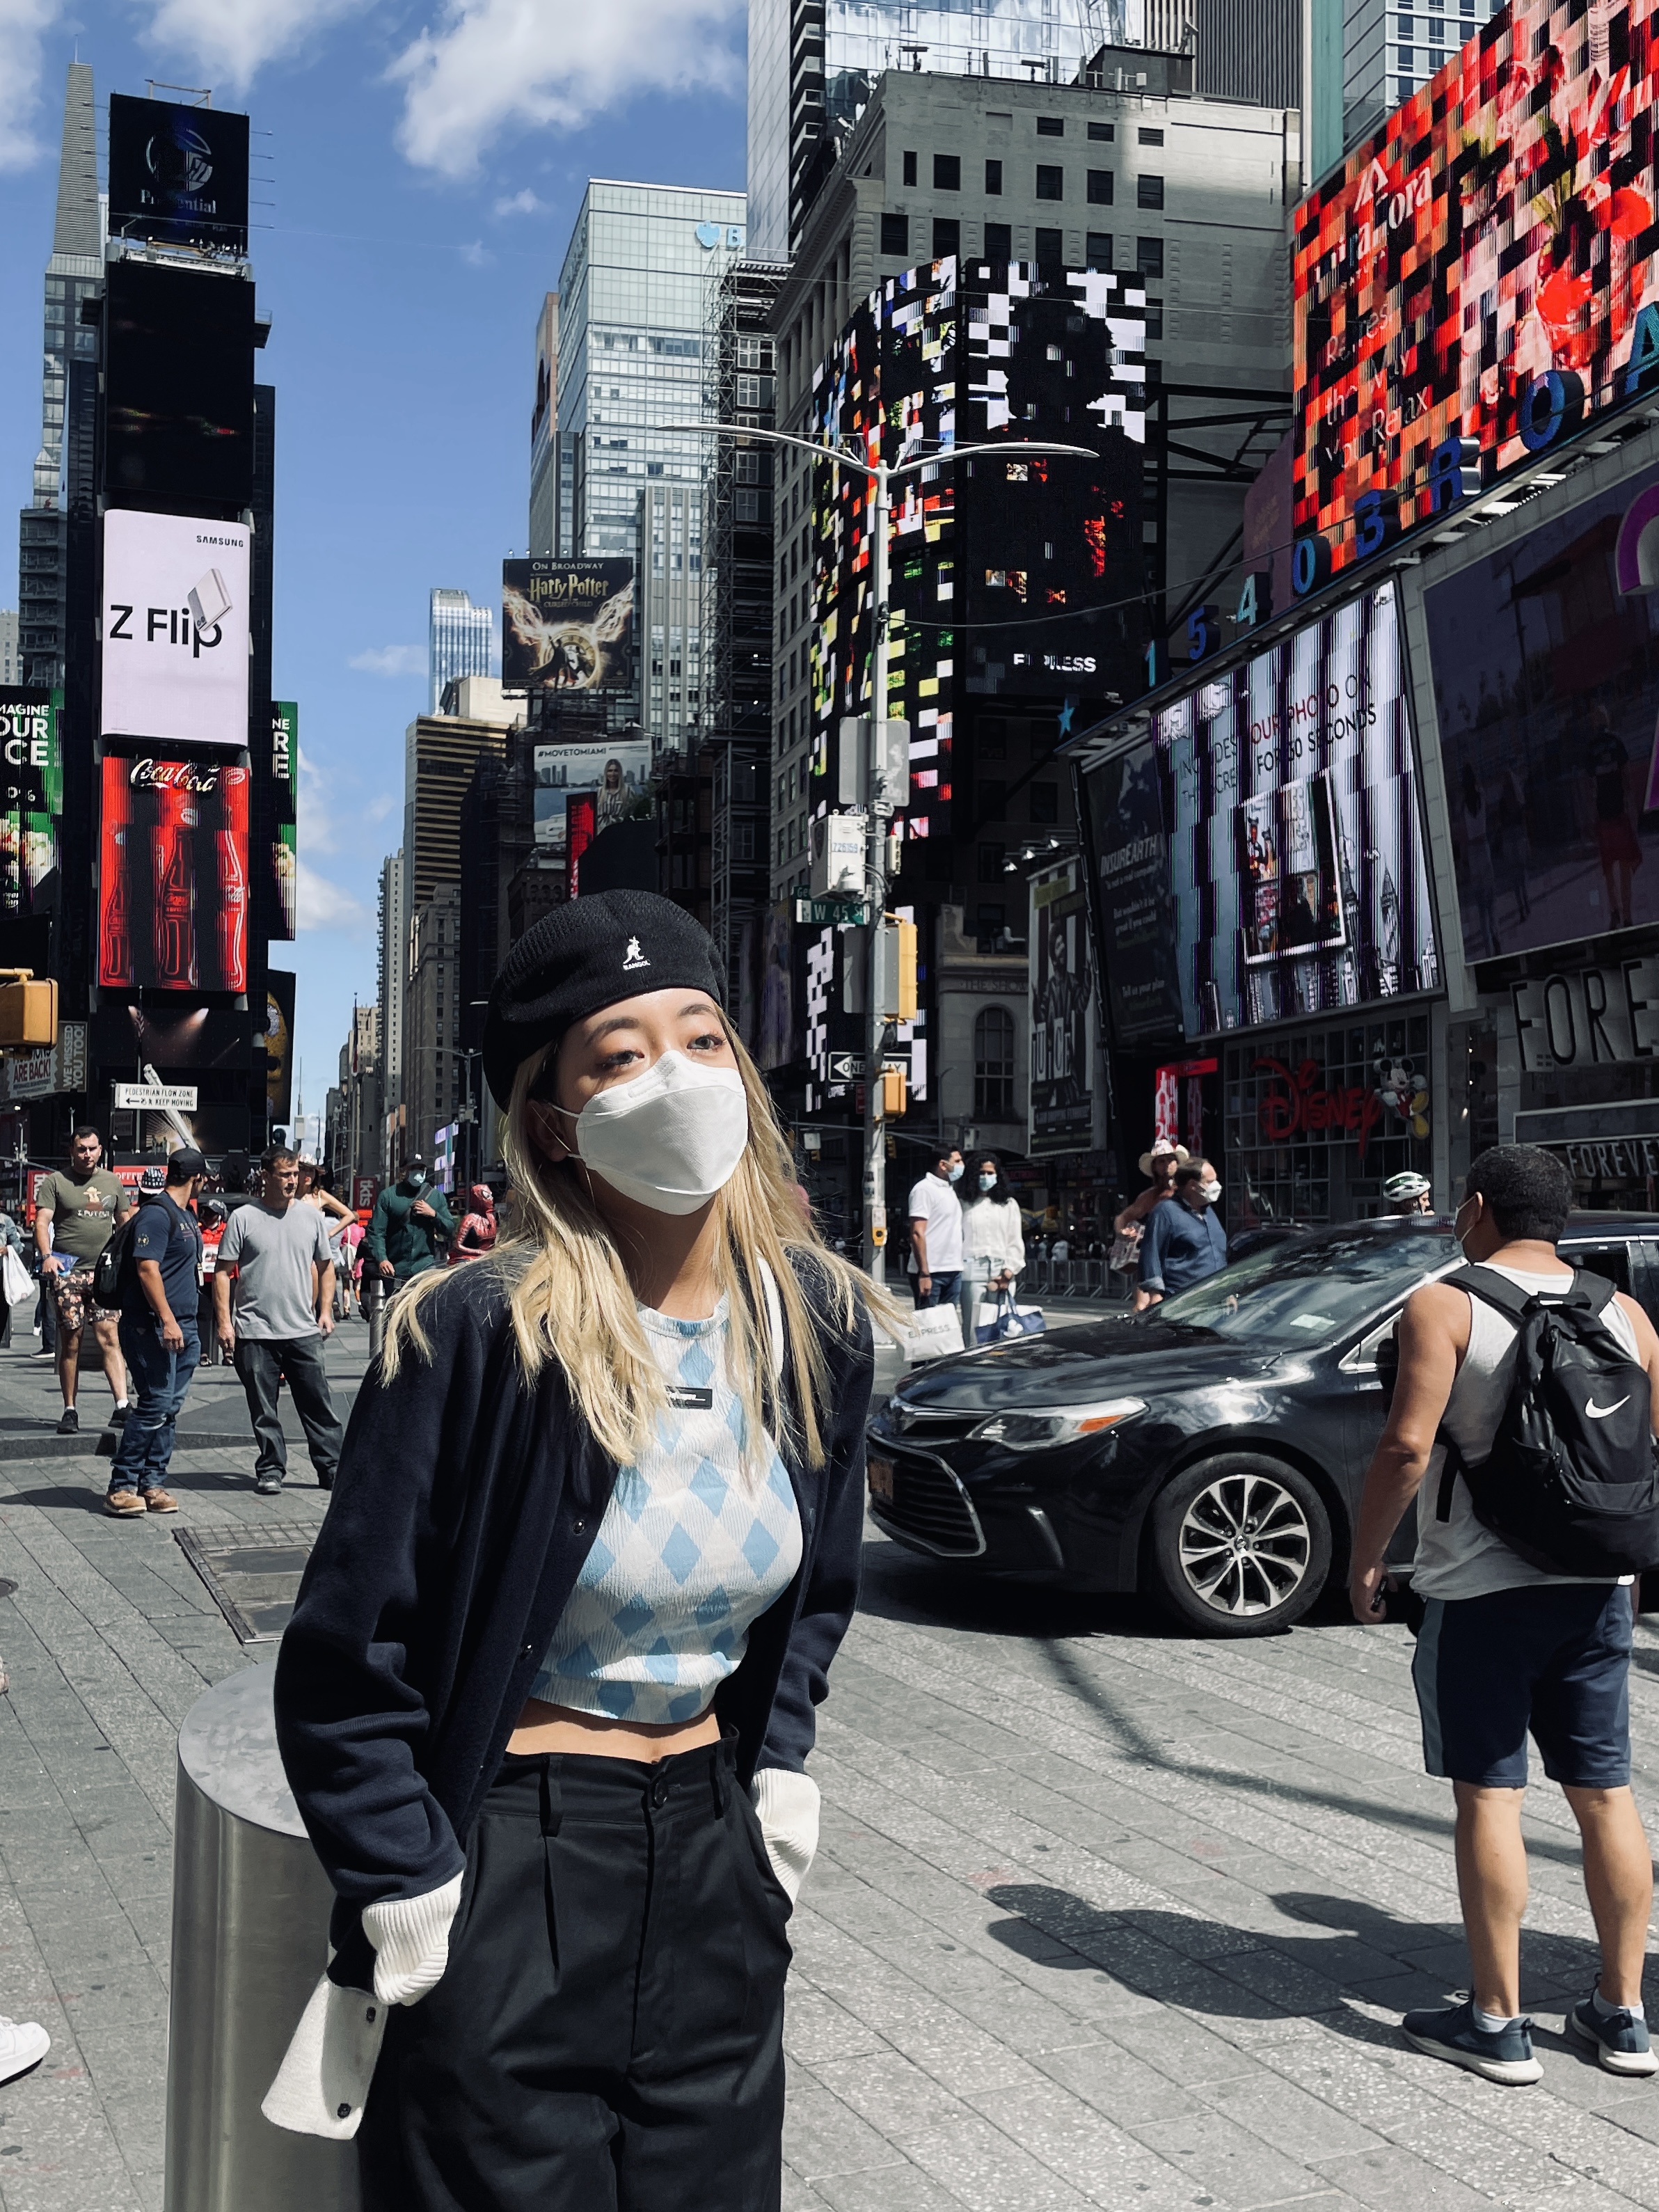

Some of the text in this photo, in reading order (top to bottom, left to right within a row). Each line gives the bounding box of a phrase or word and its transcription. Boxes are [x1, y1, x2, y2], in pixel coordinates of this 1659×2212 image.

[1372, 386, 1429, 448] Reax
[196, 535, 244, 547] SAMSUNG
[529, 574, 609, 601] Harry Potter
[109, 604, 222, 658] Z Flip
[1308, 701, 1377, 752] SCONDS
[537, 748, 607, 757] #MOVETOMIAMI
[813, 905, 826, 920] W
[832, 906, 848, 921] 45
[1509, 955, 1655, 1071] FORE
[63, 1025, 73, 1088] WE MISSED
[73, 1025, 84, 1089] YOU TOO!
[843, 1062, 901, 1073] ONE AY
[14, 1059, 51, 1082] ARE BACK!
[125, 1088, 159, 1097] PEDESTRIAN
[161, 1089, 177, 1097] FLOW
[359, 1179, 374, 1207] tkts
[908, 1324, 951, 1338] EPRESS
